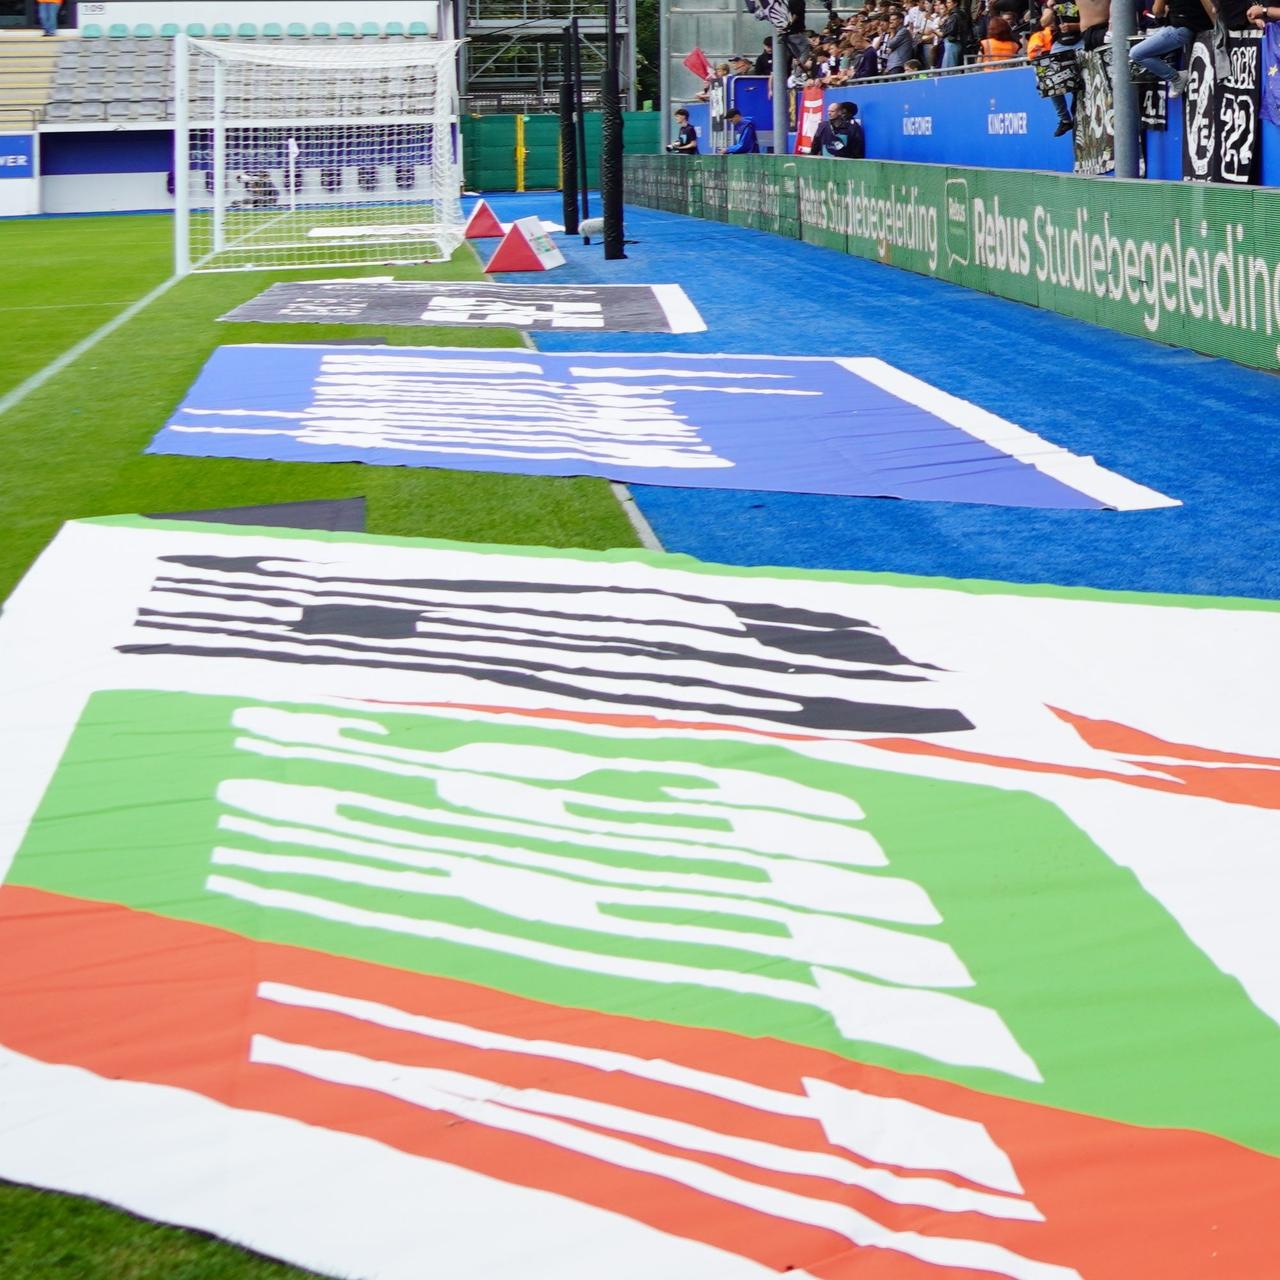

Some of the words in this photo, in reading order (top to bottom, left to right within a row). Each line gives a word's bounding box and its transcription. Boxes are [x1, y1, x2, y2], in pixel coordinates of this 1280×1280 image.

[987, 113, 1004, 135] KING
[1004, 111, 1028, 135] POWER
[800, 175, 827, 229] Rebus
[828, 179, 938, 271] Studiebegeleiding
[974, 195, 1030, 276] Rebus
